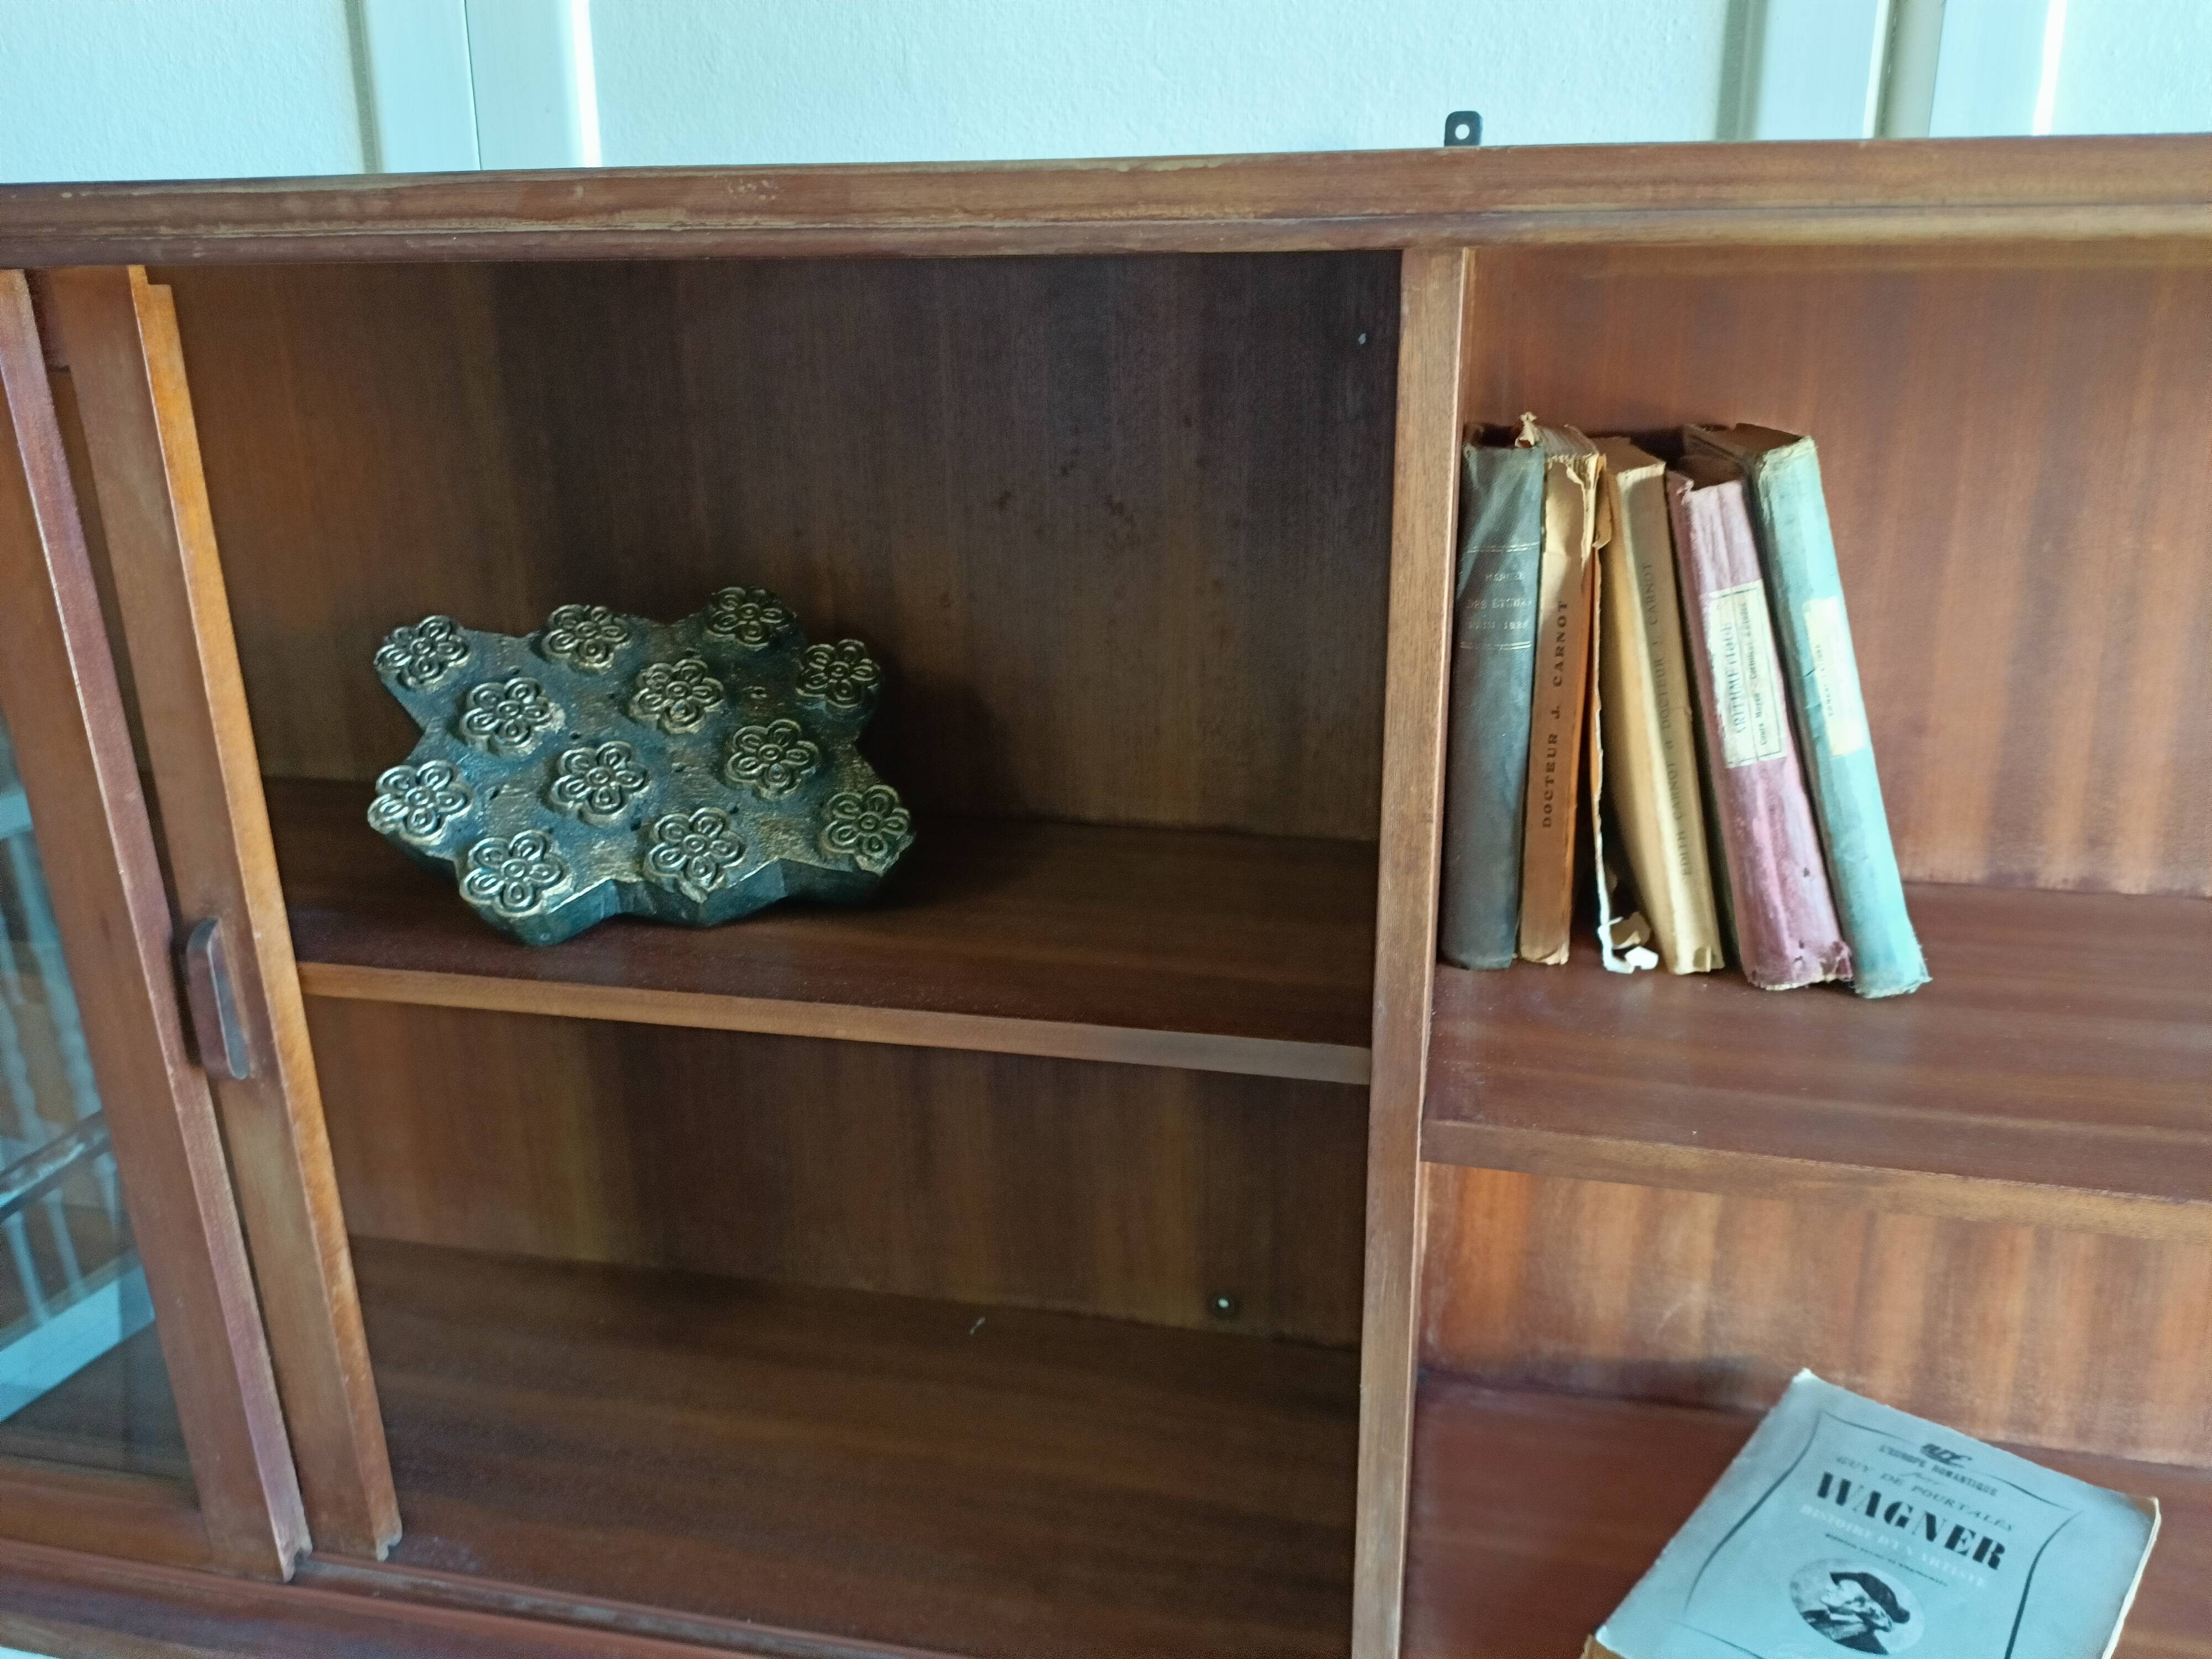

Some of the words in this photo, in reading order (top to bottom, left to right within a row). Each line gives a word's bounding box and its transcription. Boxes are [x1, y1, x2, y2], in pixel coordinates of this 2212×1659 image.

[1643, 564, 1658, 626] CARNOT
[1542, 734, 1558, 828] DOCTEUR
[1552, 601, 1568, 687] CARNOT
[1666, 763, 1682, 821] CARNOT
[1932, 1464, 1998, 1496] ROMANTIQUE
[1817, 1470, 2005, 1571] WAGNER
